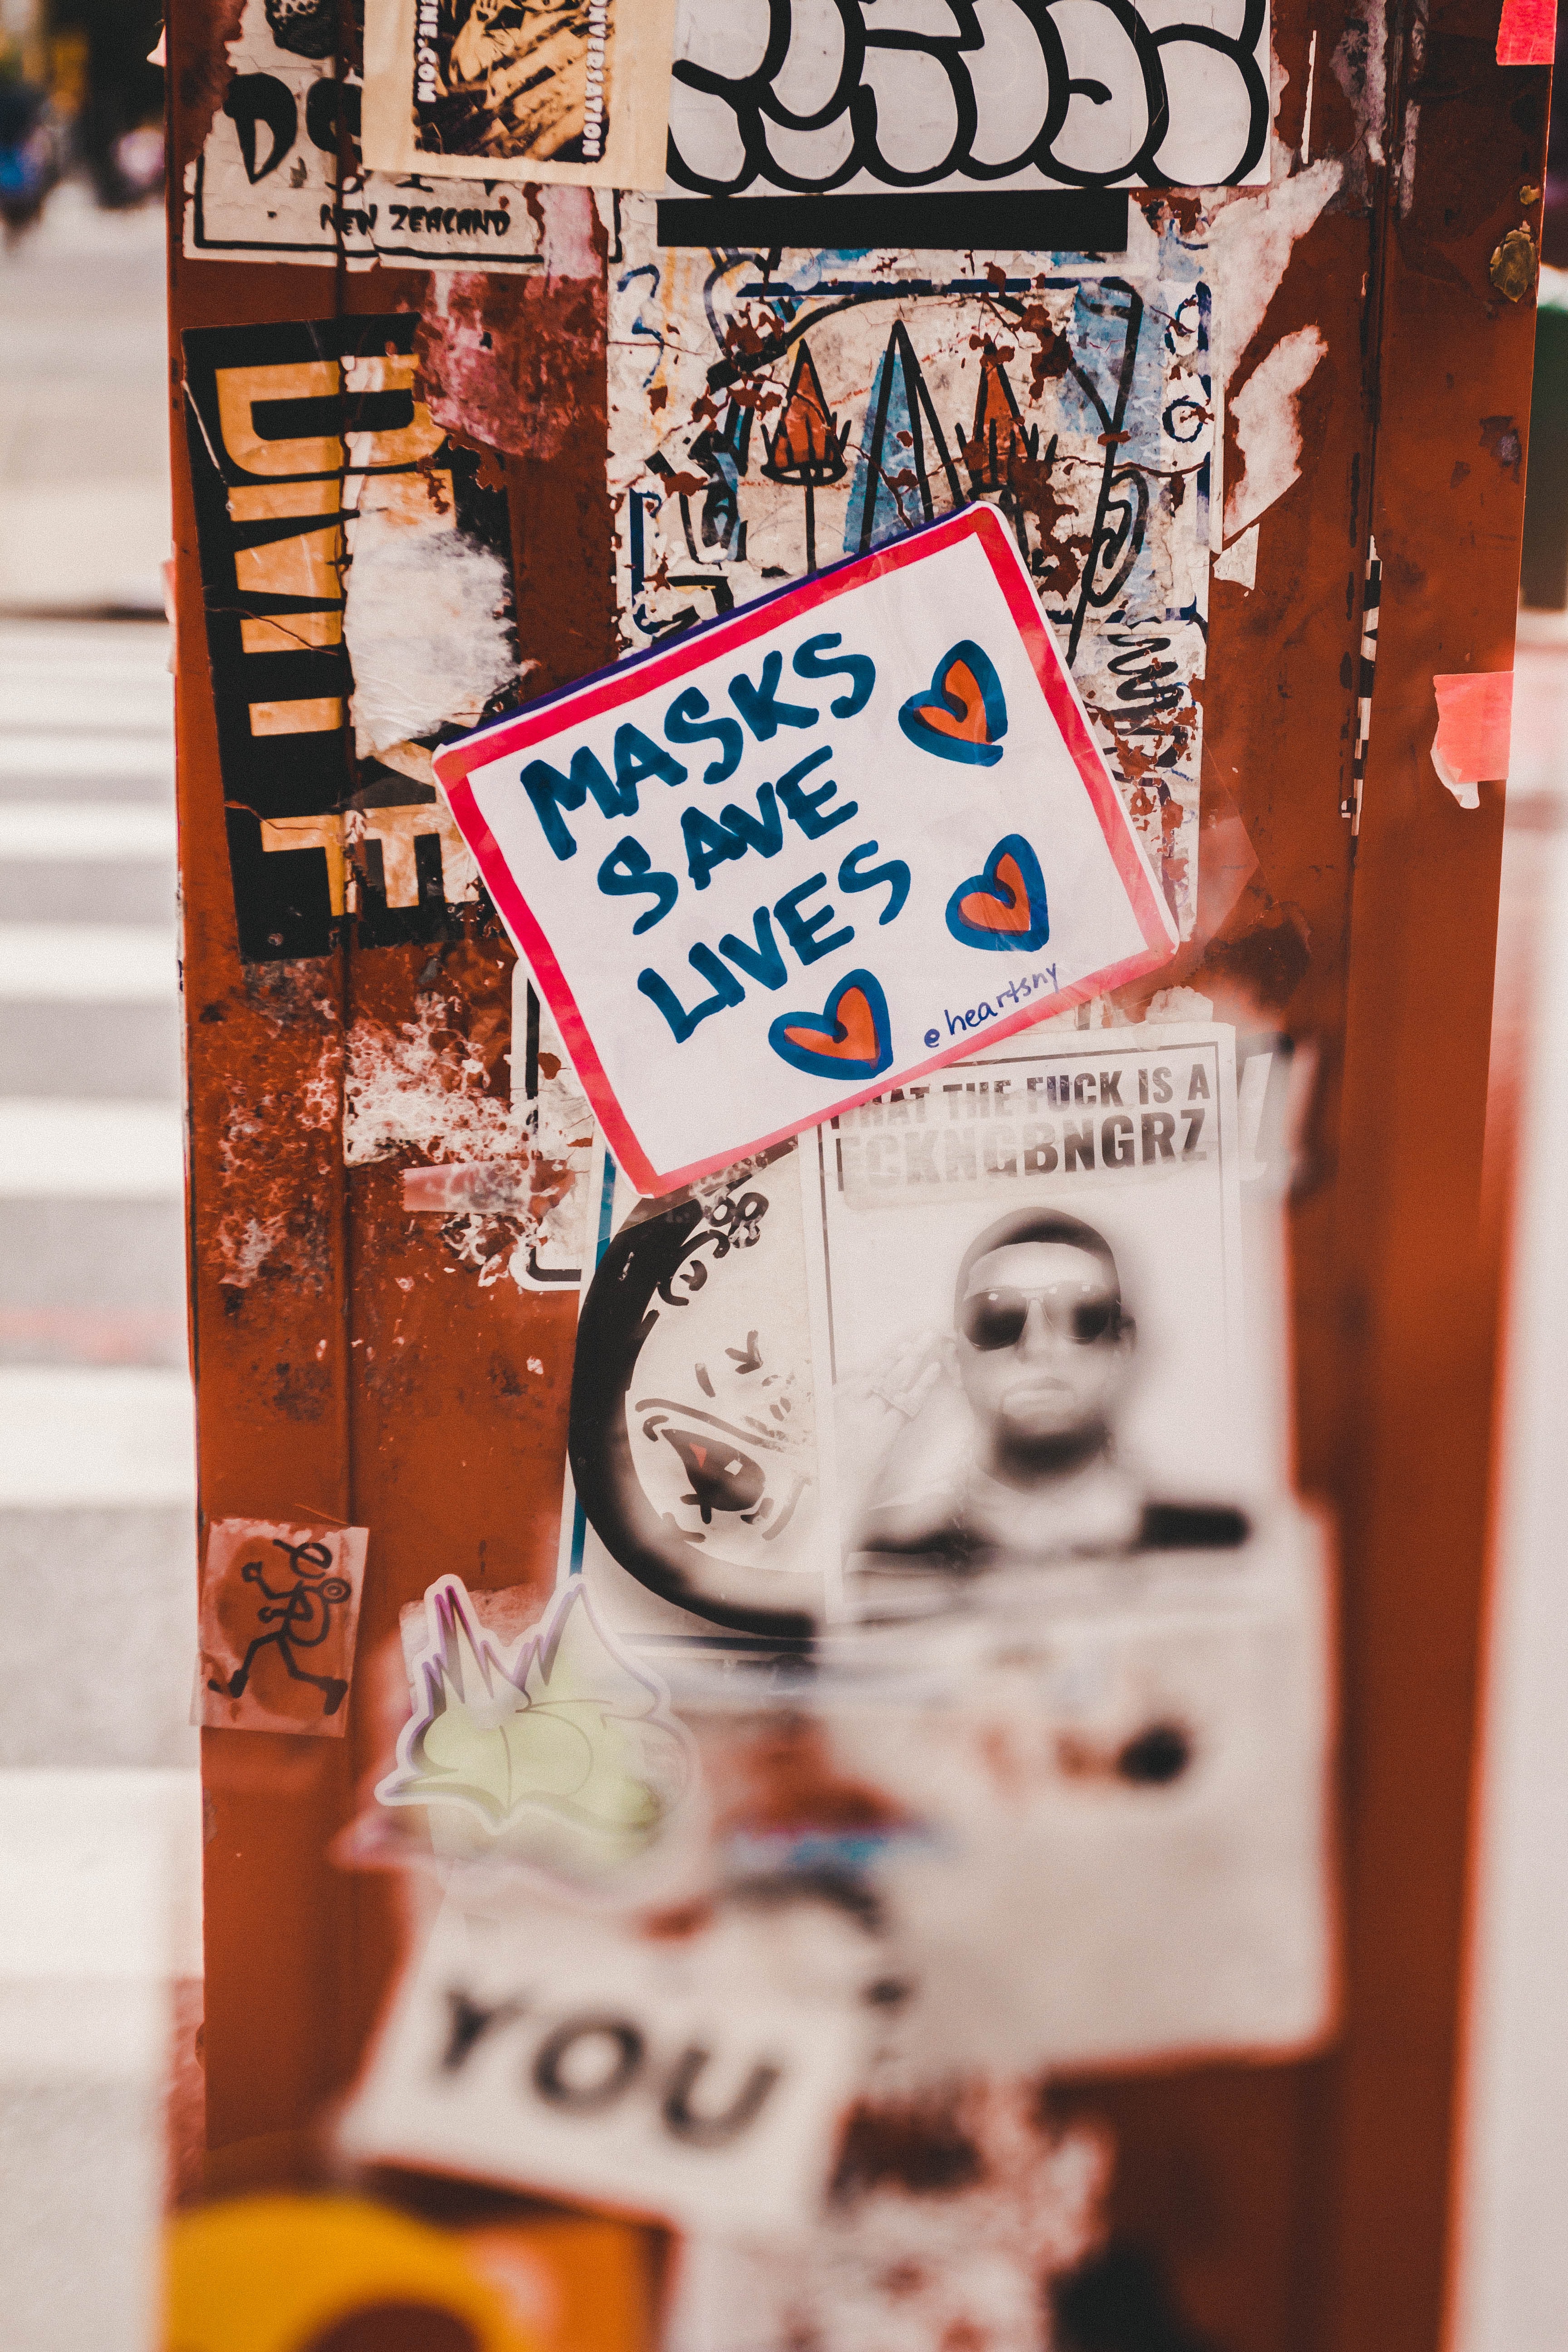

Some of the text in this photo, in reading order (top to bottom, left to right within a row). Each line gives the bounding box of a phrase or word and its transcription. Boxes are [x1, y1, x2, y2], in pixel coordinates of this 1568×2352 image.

[320, 203, 377, 236] NEW
[520, 632, 877, 860] MASKS
[597, 745, 858, 935] SAVE
[637, 839, 911, 1044] LIVES
[830, 1063, 1211, 1130] HAT THE FUCK IS A
[439, 1974, 785, 2151] YOU
